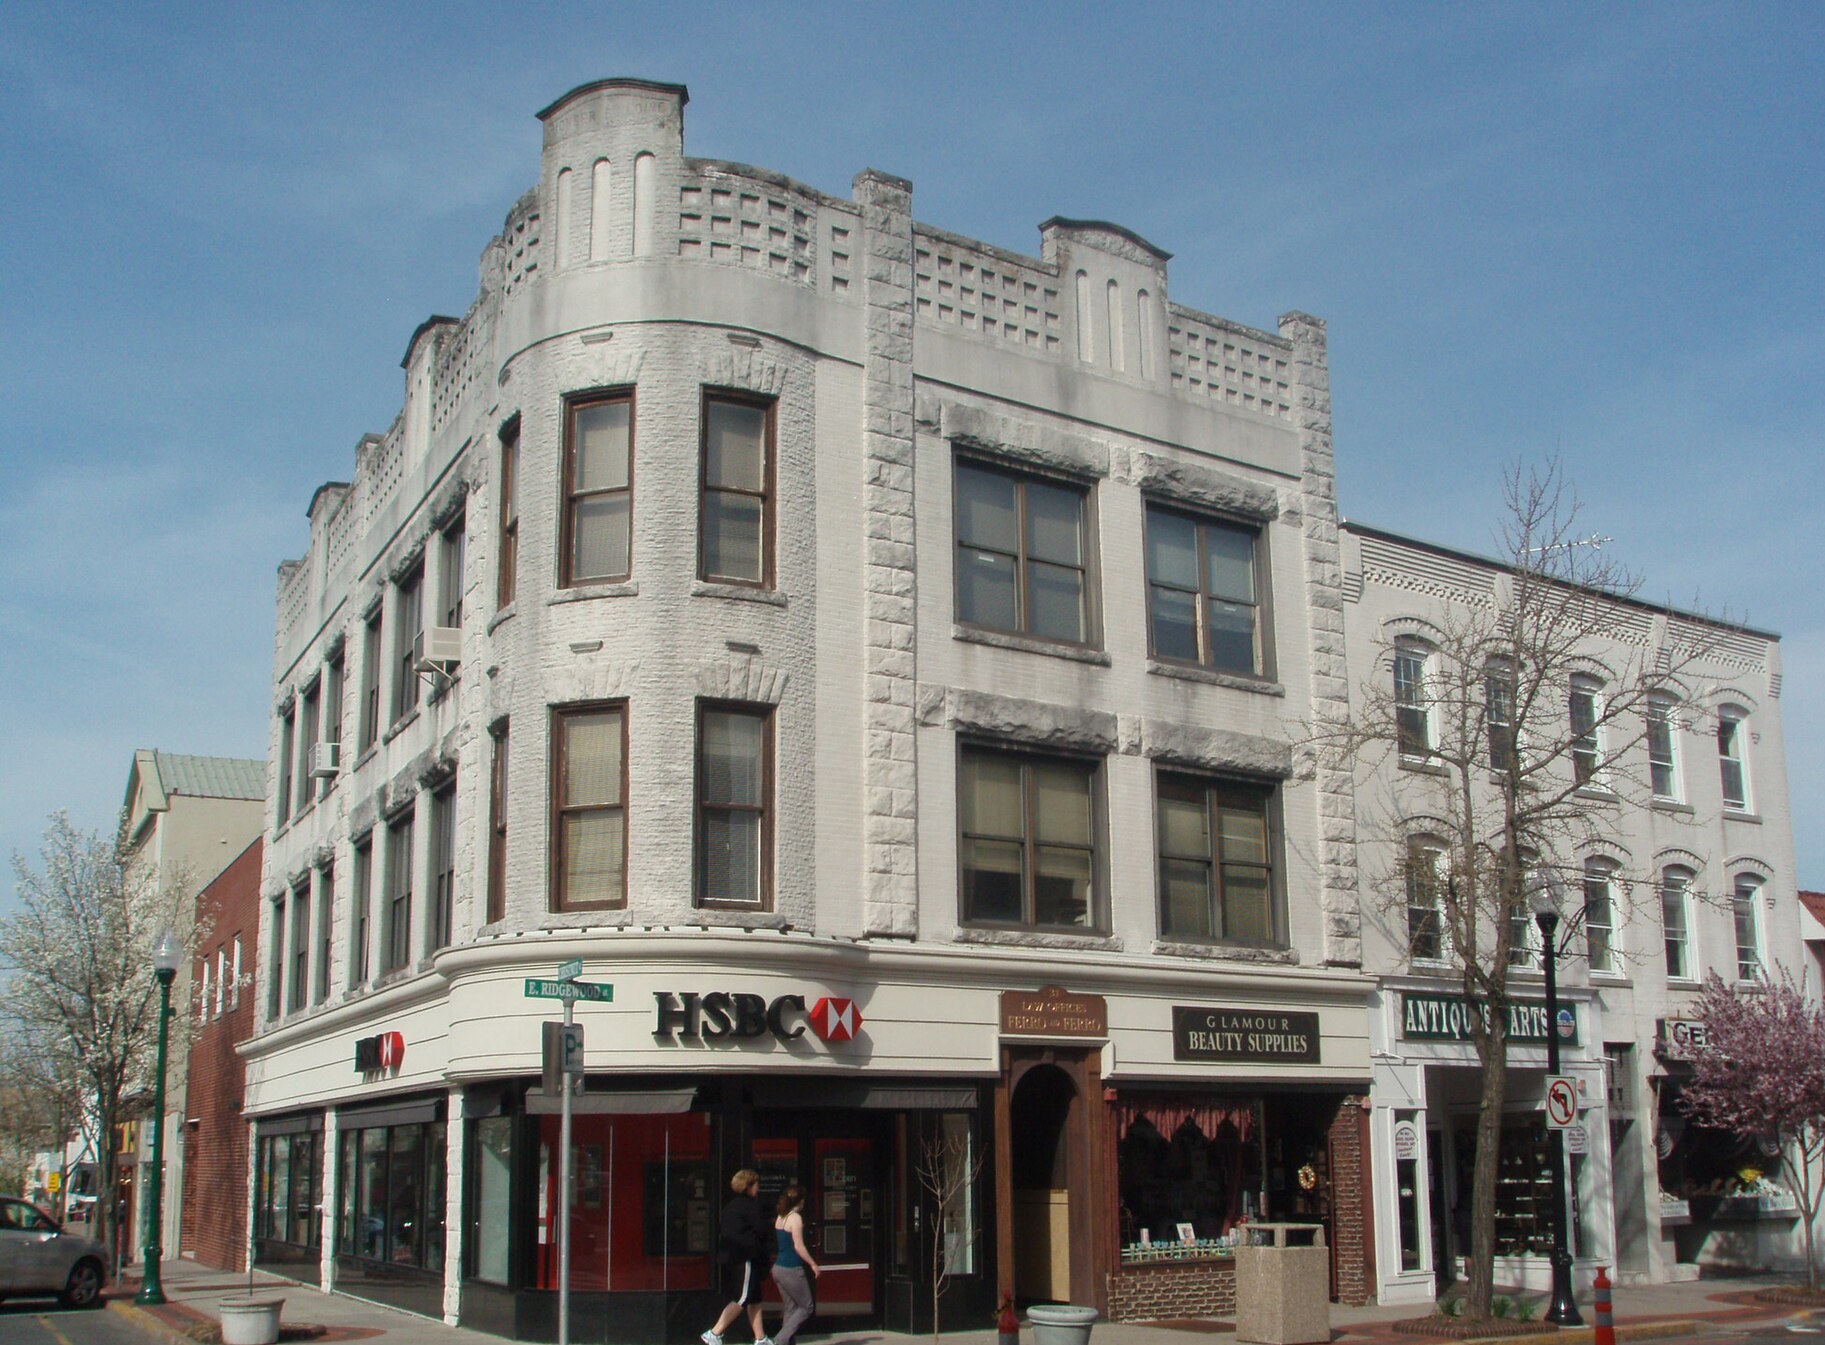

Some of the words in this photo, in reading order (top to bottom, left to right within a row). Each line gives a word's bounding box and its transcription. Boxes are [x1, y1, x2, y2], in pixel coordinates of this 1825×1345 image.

[528, 981, 539, 995] E.
[541, 982, 601, 998] RIDGEWOOD
[651, 991, 806, 1039] HSBC
[1022, 1001, 1044, 1012] LAW
[1047, 1002, 1087, 1014] OFFICES
[1008, 1015, 1047, 1030] FERRO
[1063, 1017, 1101, 1031] FERRO
[1206, 1015, 1289, 1031] GLAMOUR
[1406, 1000, 1491, 1040] ANTIQUS
[565, 1033, 576, 1066] P
[1188, 1031, 1243, 1051] BEAUTY
[1248, 1033, 1308, 1054] SUPPLIES
